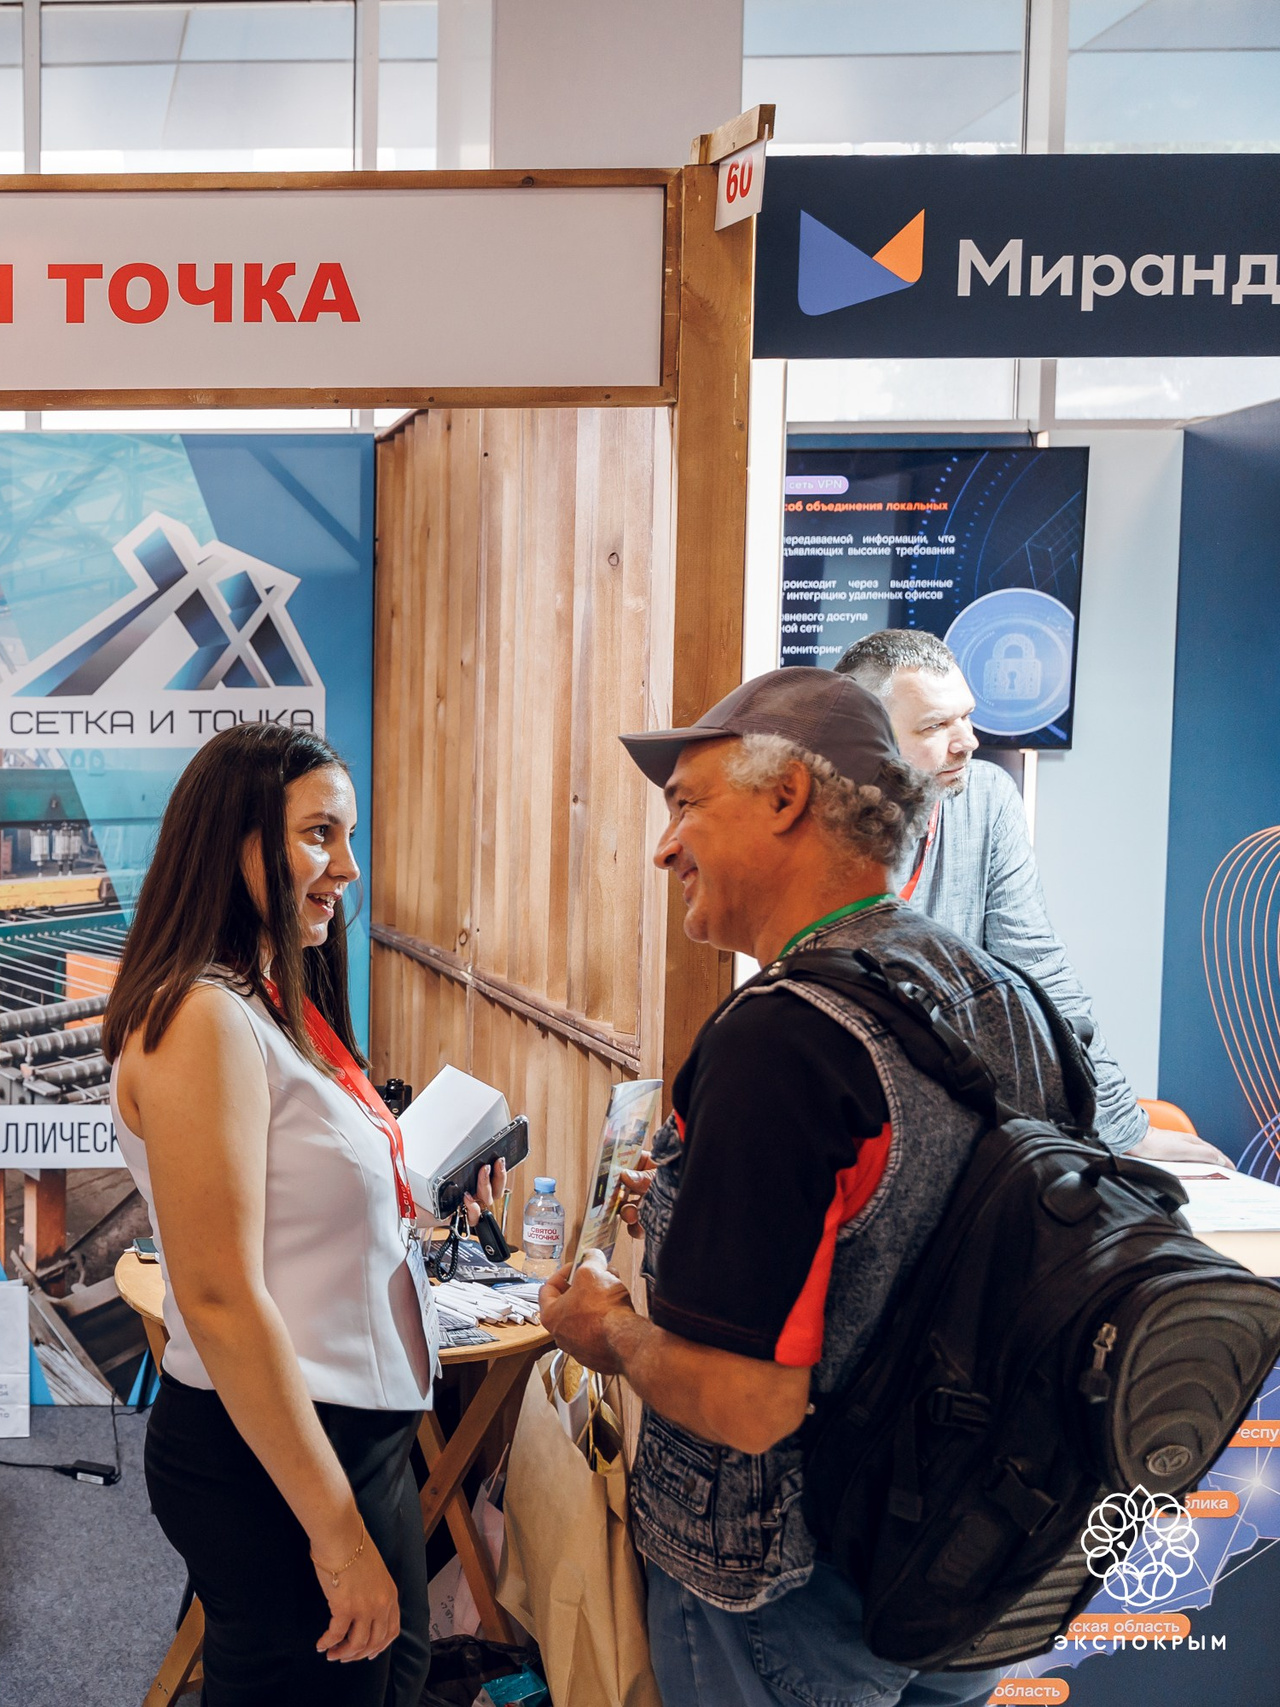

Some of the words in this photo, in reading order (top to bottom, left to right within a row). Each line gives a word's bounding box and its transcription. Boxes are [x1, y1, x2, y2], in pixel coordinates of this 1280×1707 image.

[725, 159, 753, 204] 60
[957, 238, 1280, 311] Миранд
[47, 261, 361, 326] ТОЧКА
[788, 481, 814, 490] сеть
[817, 479, 843, 489] VPN
[805, 500, 883, 512] объединения
[885, 501, 949, 512] локальных
[783, 534, 854, 547] ередаваемой
[937, 535, 956, 545] что
[847, 547, 891, 556] высокие
[895, 545, 956, 558] требования
[848, 579, 879, 591] через
[890, 578, 954, 590] выделенные
[786, 590, 847, 602] интеграцию
[848, 590, 904, 602] удаленных
[904, 590, 944, 602] офисов
[826, 612, 868, 624] доступа
[799, 624, 824, 634] сети
[782, 645, 843, 656] мониторинг
[10, 710, 135, 735] СЕТКА
[150, 710, 175, 735] И
[1236, 1427, 1280, 1442] еспу
[1113, 1619, 1180, 1634] область
[994, 1683, 1061, 1697] область
